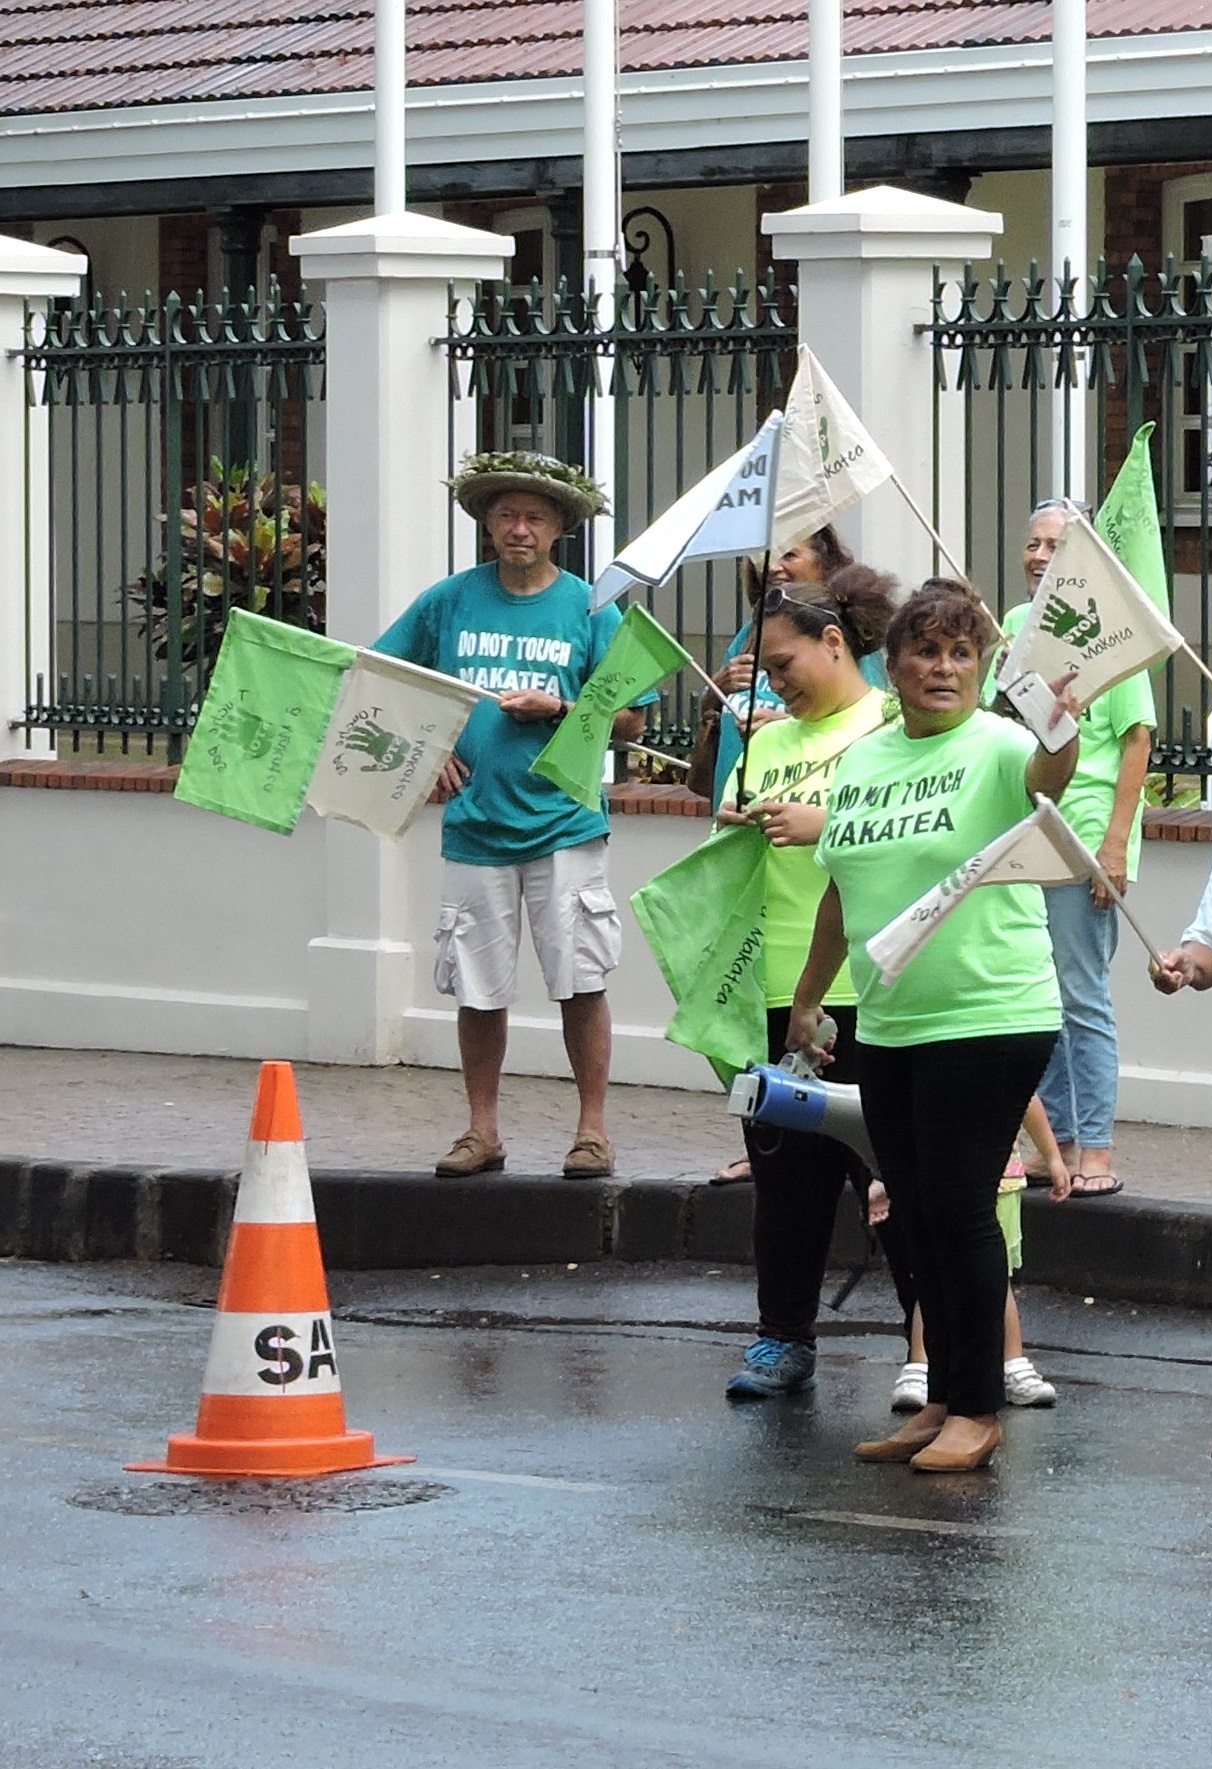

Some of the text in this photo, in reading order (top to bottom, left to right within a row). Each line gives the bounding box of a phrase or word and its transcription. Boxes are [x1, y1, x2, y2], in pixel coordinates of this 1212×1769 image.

[1056, 577, 1087, 590] pas
[1061, 611, 1100, 644] STOP
[457, 630, 572, 667] DO NOT TOUCH
[759, 768, 779, 794] DO
[835, 784, 860, 813] DO
[861, 781, 900, 809] NOT
[901, 767, 966, 806] TOUCH
[825, 807, 956, 848] MAKATEA
[715, 927, 765, 1005] Makatea
[254, 1319, 337, 1385] SA
